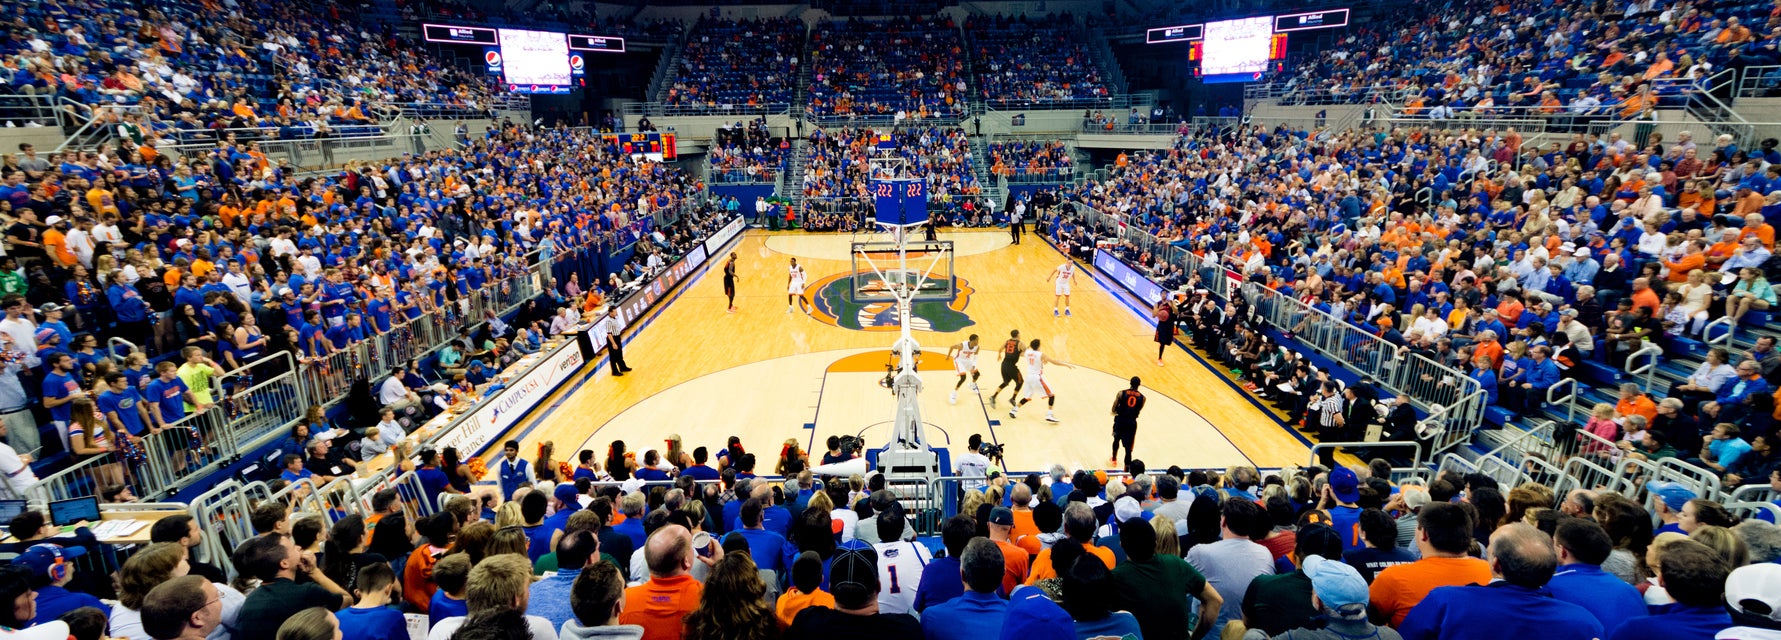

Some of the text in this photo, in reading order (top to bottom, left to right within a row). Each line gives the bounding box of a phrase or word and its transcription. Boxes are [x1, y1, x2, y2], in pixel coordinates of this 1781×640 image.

[559, 350, 580, 371] verizon
[1127, 395, 1137, 407] 0
[461, 415, 481, 439] Hill
[887, 564, 901, 594] 1
